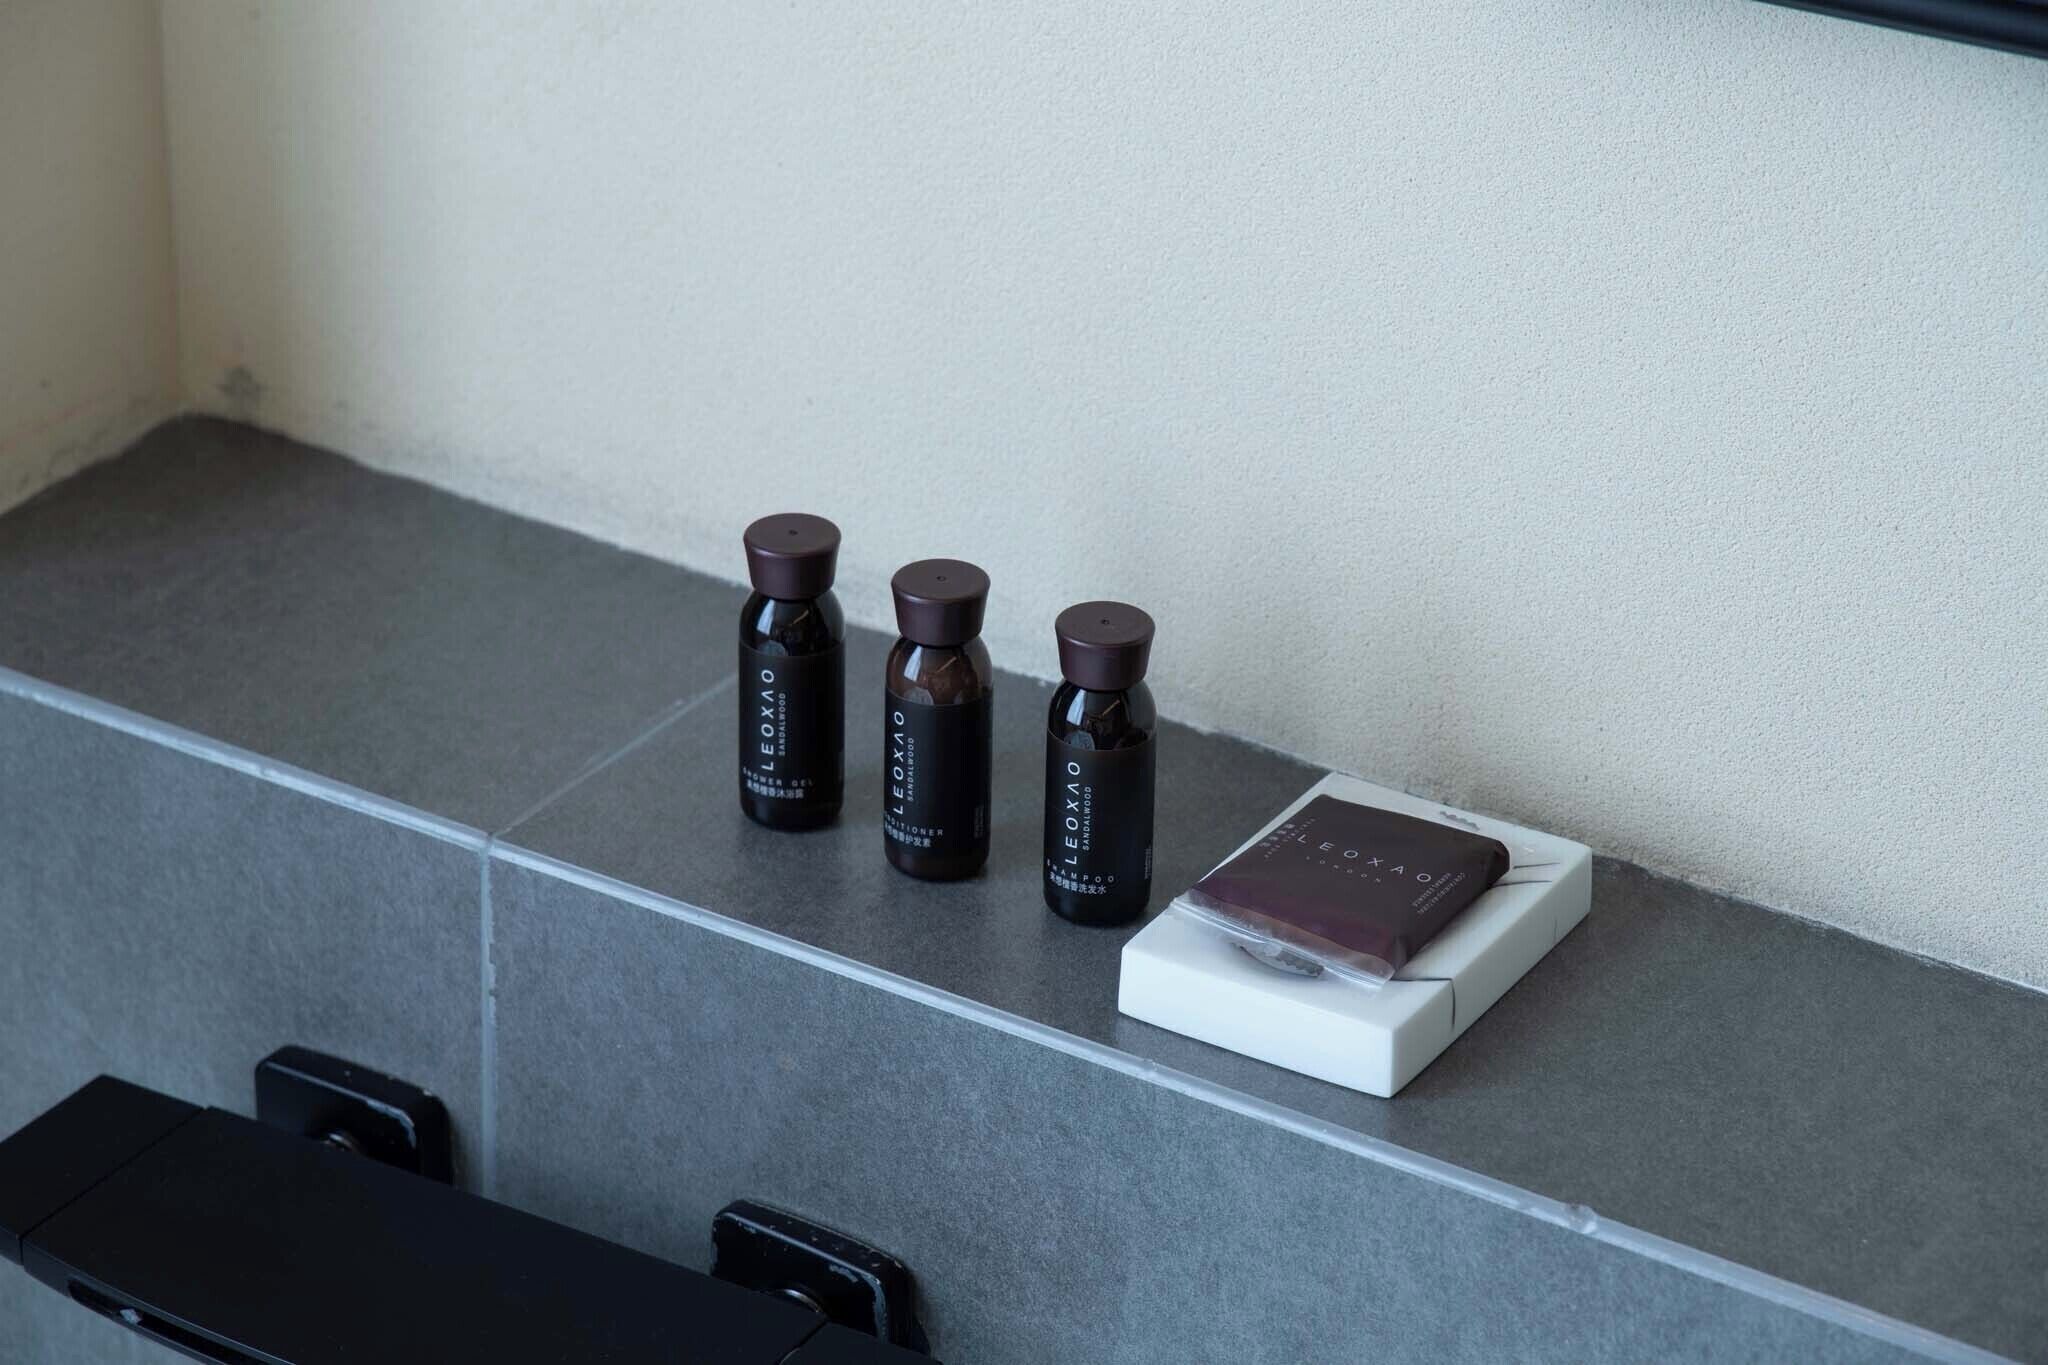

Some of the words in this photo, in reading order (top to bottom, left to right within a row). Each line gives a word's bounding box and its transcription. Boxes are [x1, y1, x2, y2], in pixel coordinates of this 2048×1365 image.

[778, 692, 786, 757] SANDALWOOD
[907, 737, 915, 801] SANDALWOOD
[884, 812, 944, 836] DITIONER
[1082, 786, 1092, 851] SANDALWOOD
[1297, 833, 1432, 883] LEOXAO
